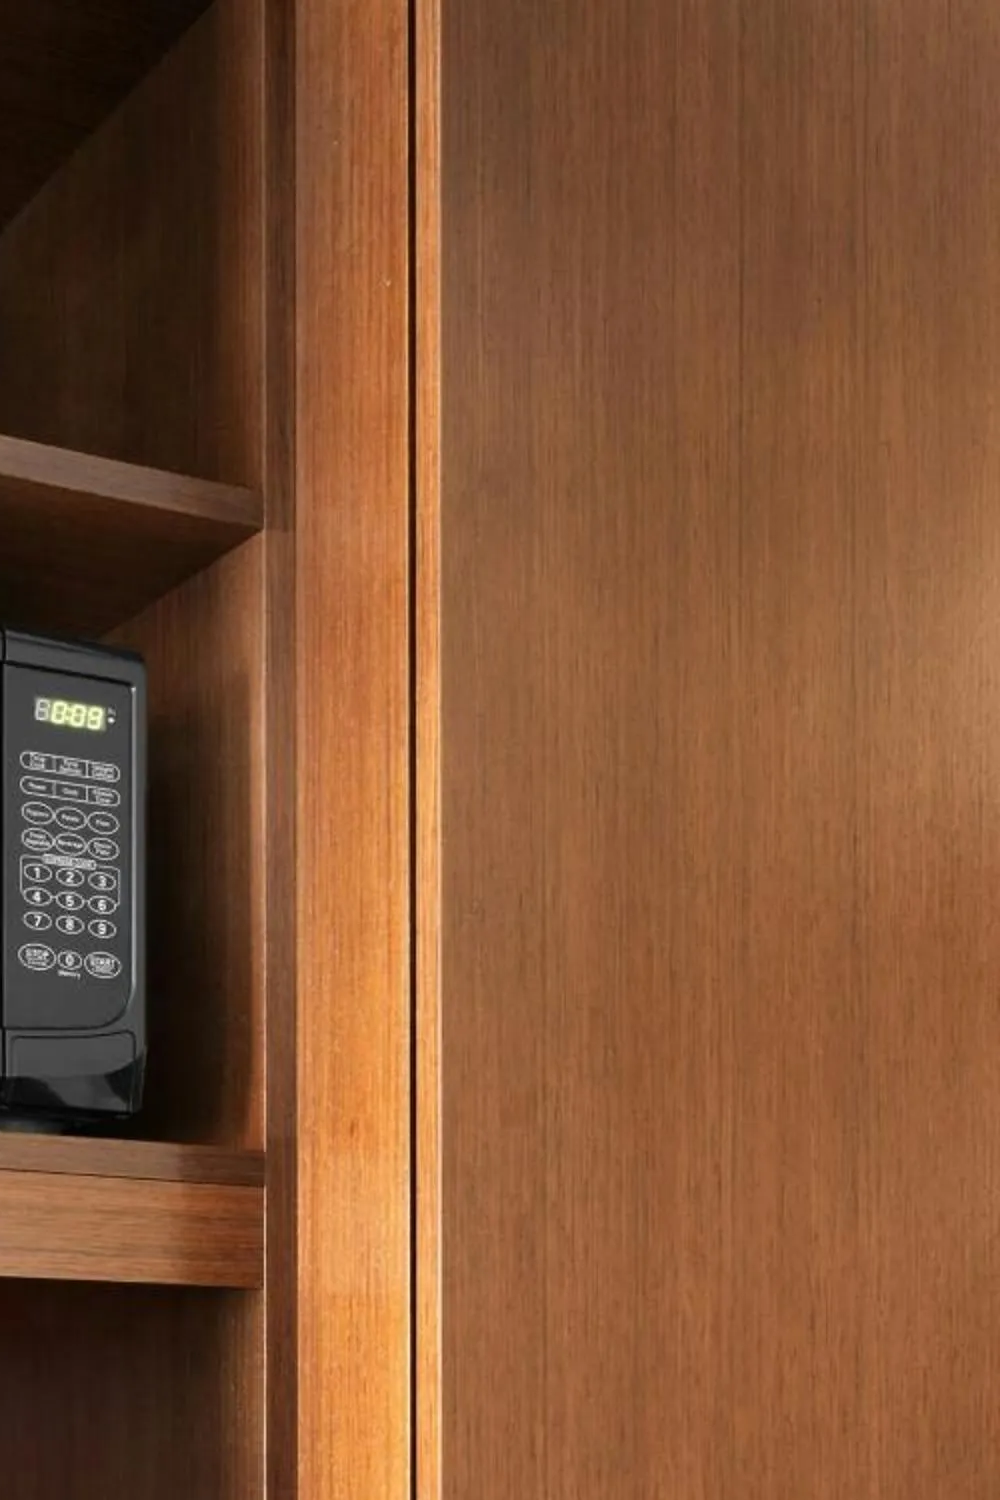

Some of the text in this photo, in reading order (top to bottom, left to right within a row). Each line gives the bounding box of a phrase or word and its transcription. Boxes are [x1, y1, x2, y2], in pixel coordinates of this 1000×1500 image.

[33, 866, 41, 879] 1
[65, 871, 75, 883] 2
[97, 875, 107, 887] 3
[32, 891, 41, 902] 4
[65, 895, 75, 907] 5
[97, 899, 107, 911] 6
[33, 915, 42, 927] 7
[65, 918, 75, 930] 8
[97, 923, 107, 934] 9
[65, 953, 75, 967] 0
